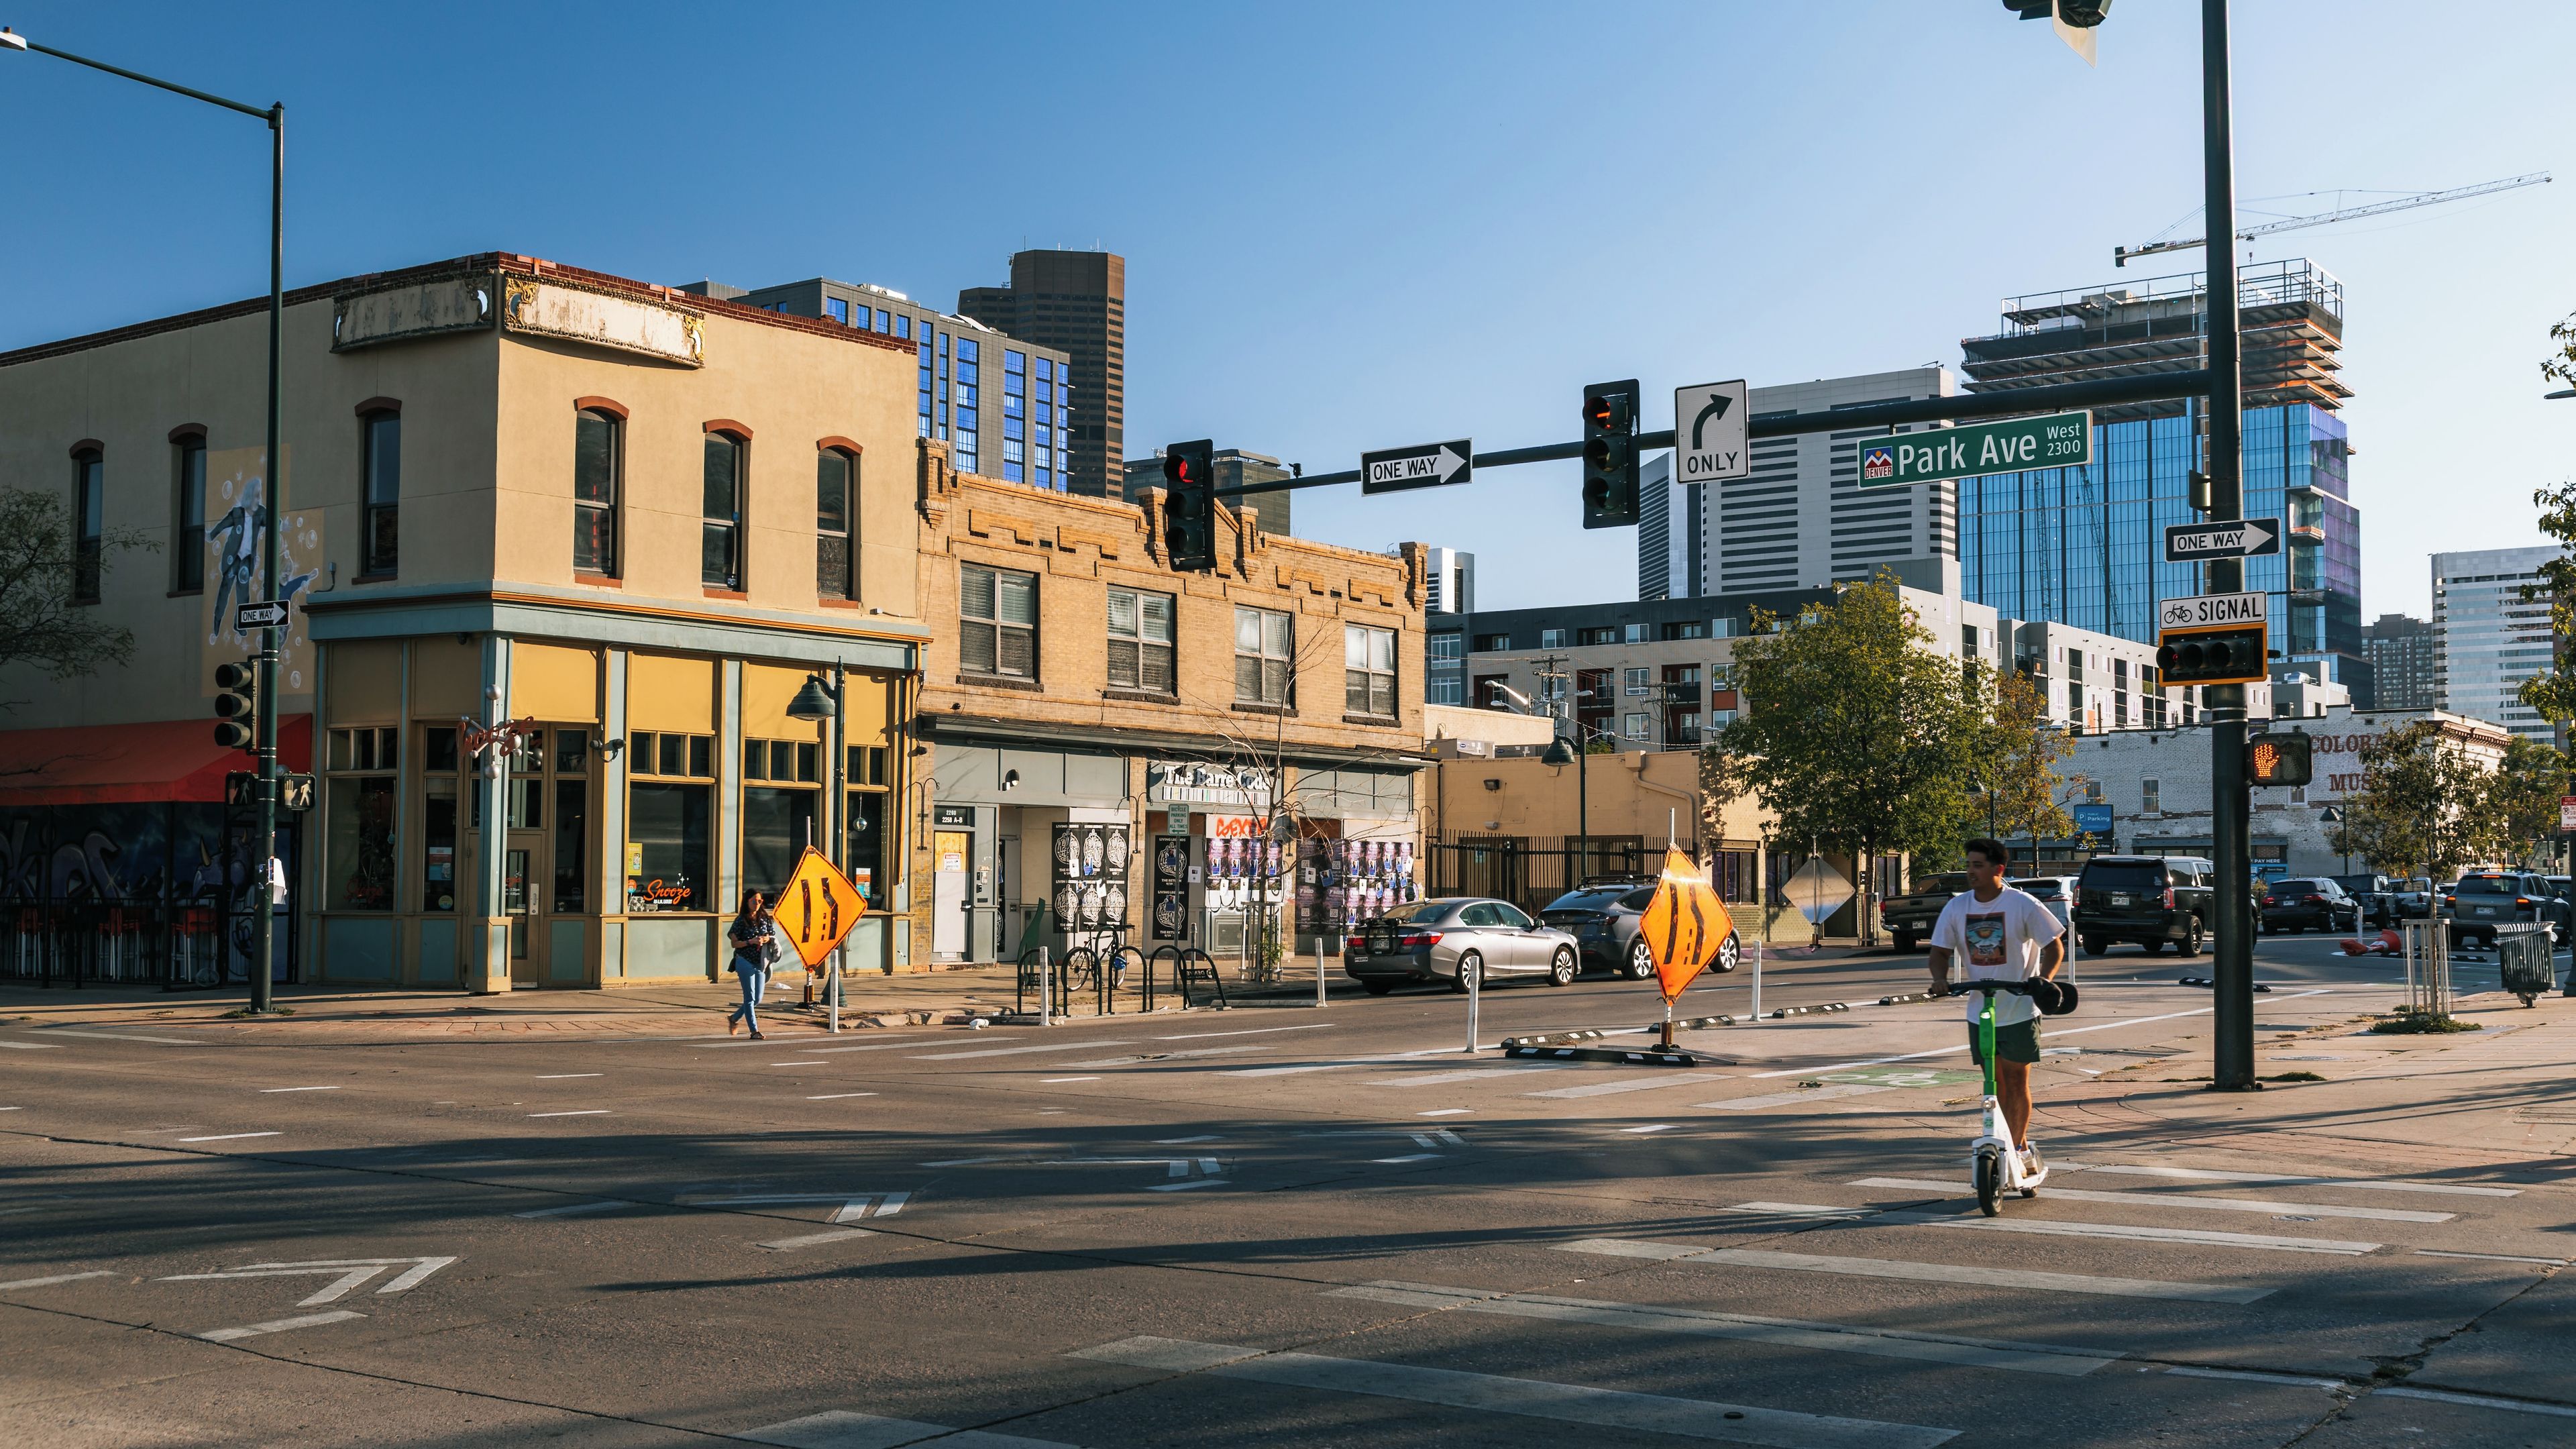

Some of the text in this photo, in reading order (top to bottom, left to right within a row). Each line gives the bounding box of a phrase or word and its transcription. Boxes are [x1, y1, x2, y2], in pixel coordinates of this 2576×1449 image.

[2047, 423, 2080, 439] West
[1898, 434, 2037, 475] Park Ave
[2047, 439, 2081, 456] 2300
[1374, 457, 1438, 480] ONE WAY
[1687, 451, 1738, 474] ONLY
[1865, 467, 1892, 479] DENVER
[2178, 532, 2245, 550] ONE WAY
[243, 609, 274, 621] ONE WAY
[2198, 597, 2261, 622] SIGNAL
[1164, 766, 1271, 791] The Barre Code
[643, 879, 692, 905] Snooze
